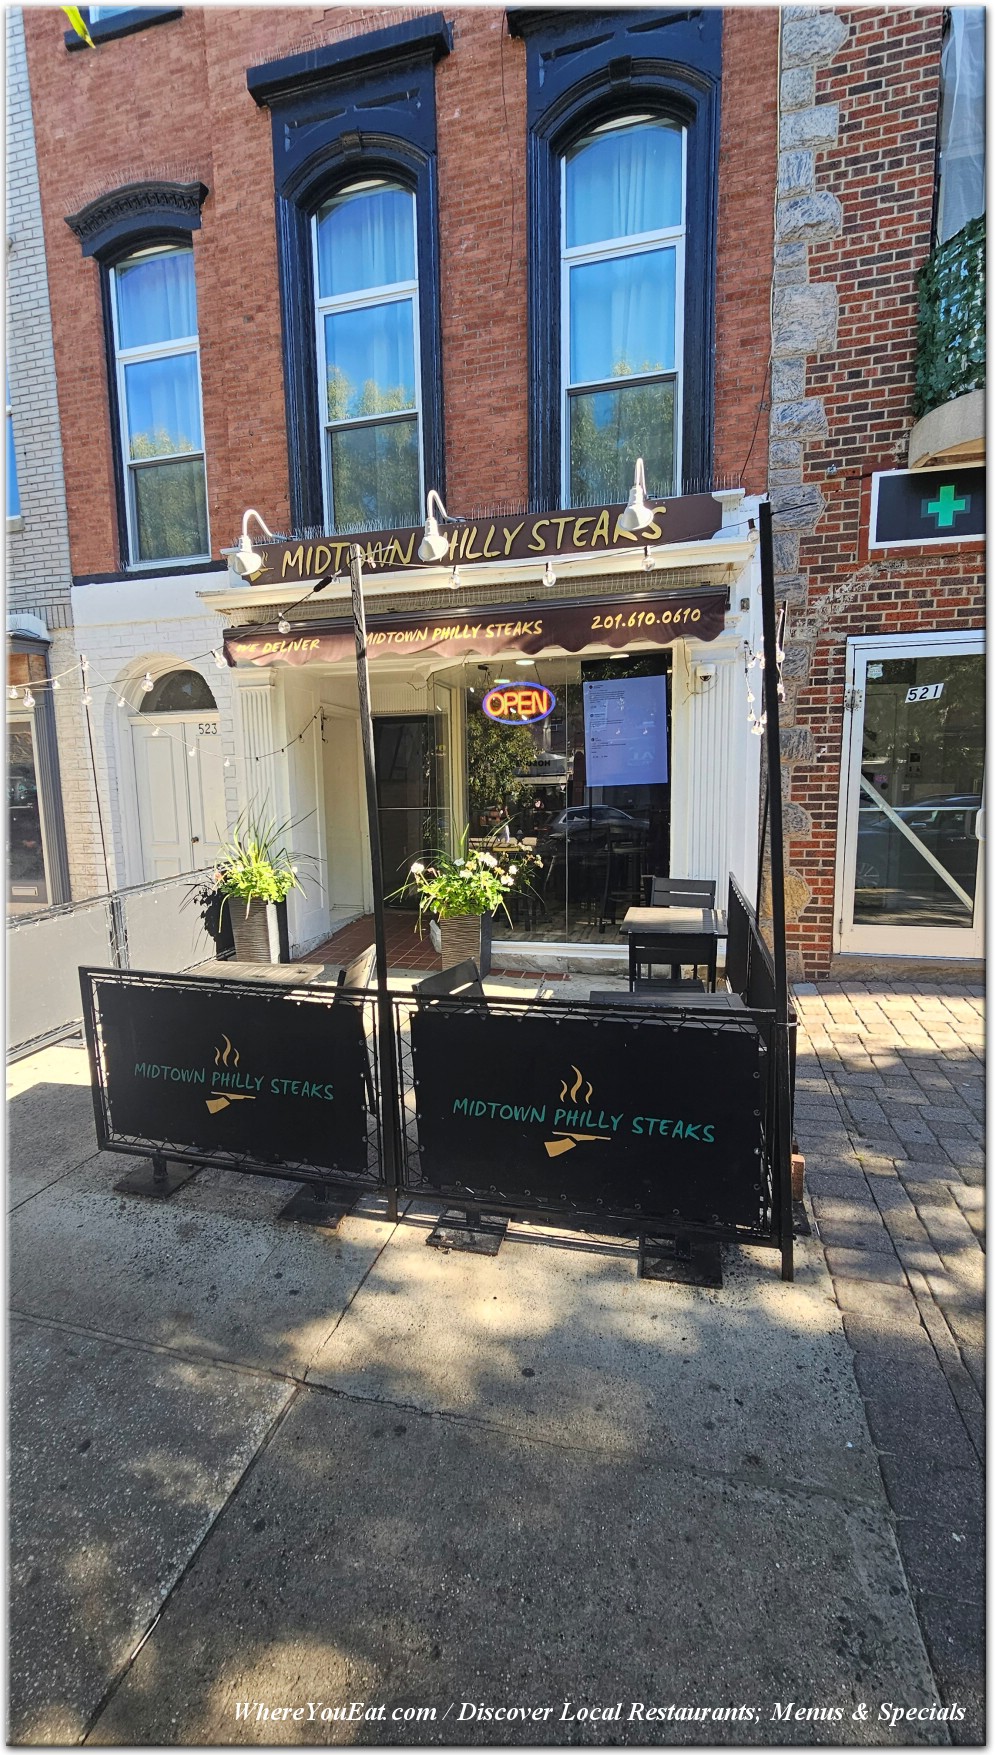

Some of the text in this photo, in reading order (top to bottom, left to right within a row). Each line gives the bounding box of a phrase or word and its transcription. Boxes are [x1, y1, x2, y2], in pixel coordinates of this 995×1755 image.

[282, 532, 415, 578] MIDTOWN
[426, 522, 524, 563] HILLY
[590, 607, 702, 630] 201.610.0610
[262, 637, 321, 654] DELIVER
[365, 619, 543, 646] MIDTOWN PHILLY STEAKS
[486, 690, 548, 717] OPEN
[908, 685, 939, 701] 521
[198, 722, 218, 735] 523
[134, 1062, 335, 1101] MIDTOWN PHILLY STEAKS
[453, 1097, 716, 1143] MIDTOWN PHILLY STEAKS
